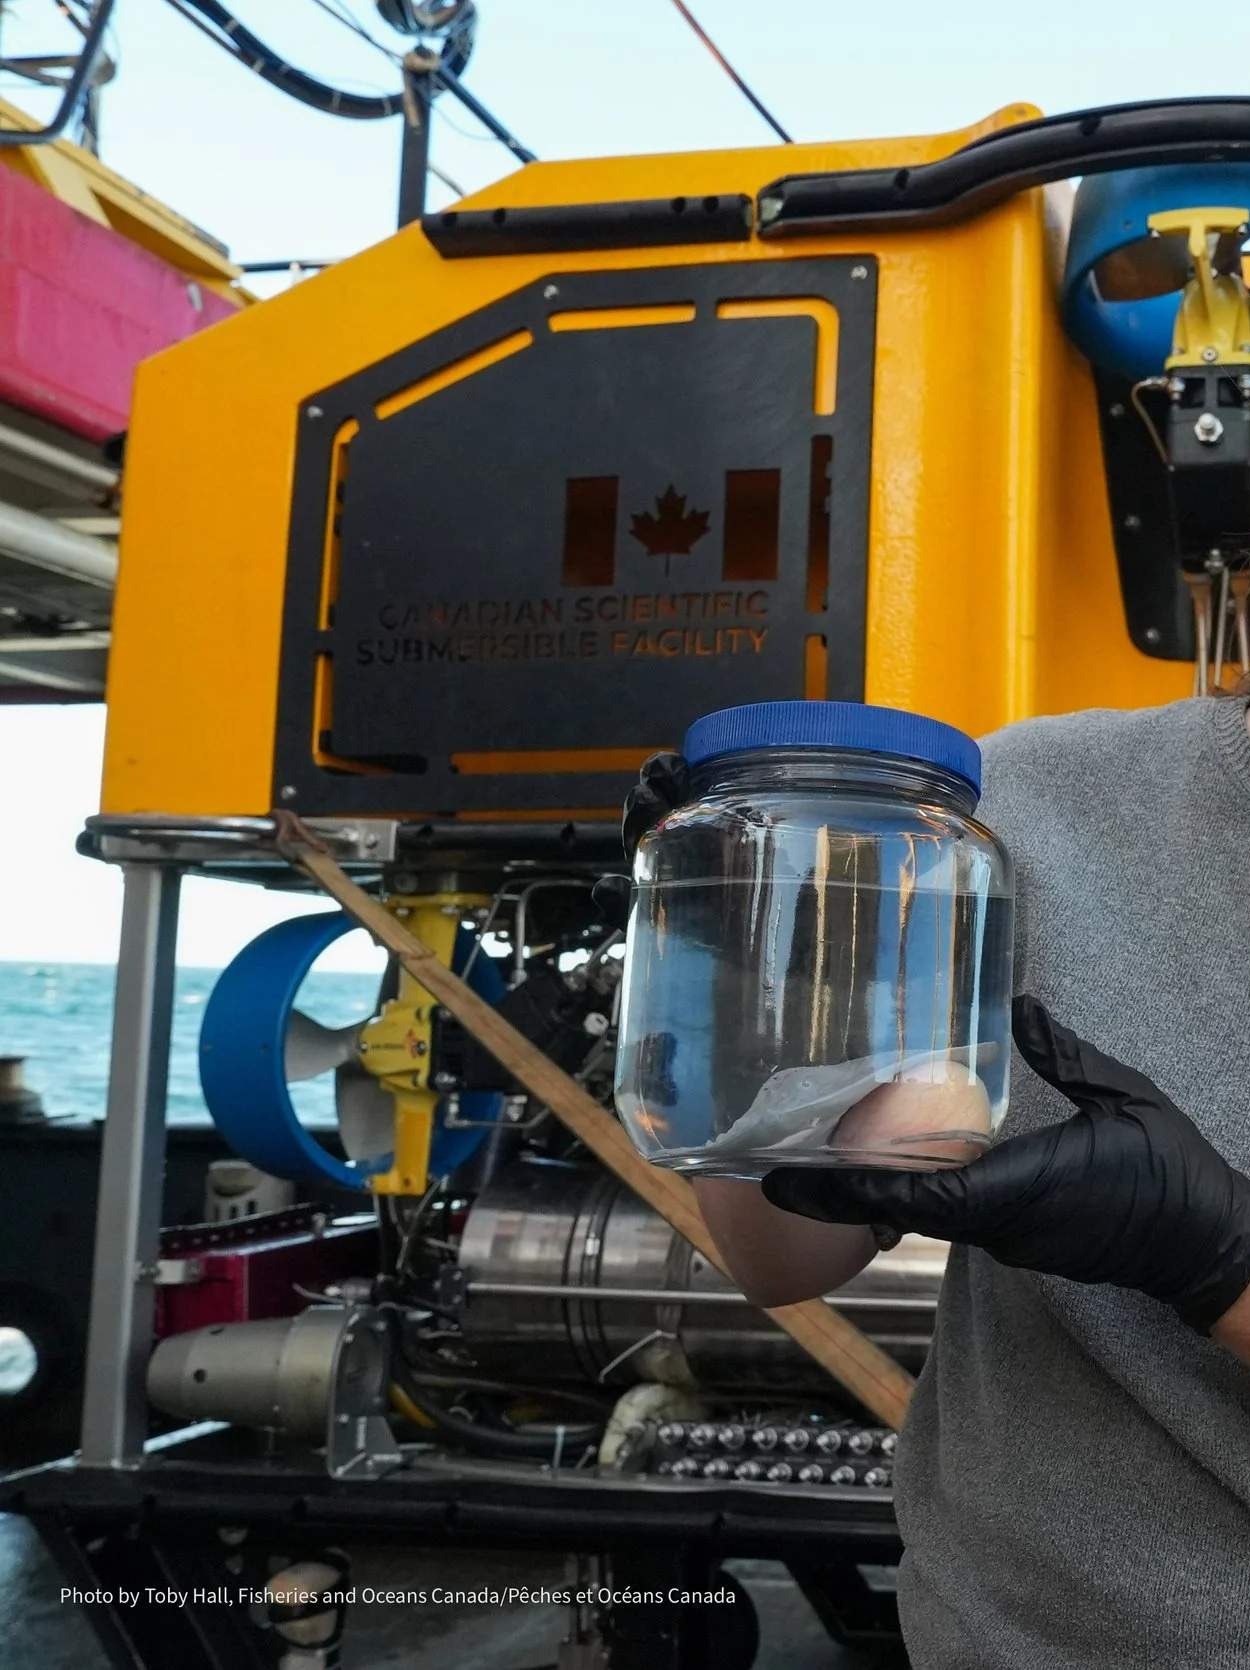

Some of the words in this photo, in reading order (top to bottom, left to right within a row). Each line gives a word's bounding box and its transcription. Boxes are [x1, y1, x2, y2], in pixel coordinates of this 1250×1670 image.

[379, 597, 563, 631] CANADIAN
[574, 590, 770, 624] SCIENTIFIC
[355, 630, 599, 666] SUBMERSIBLE
[611, 627, 769, 658] FACILITY
